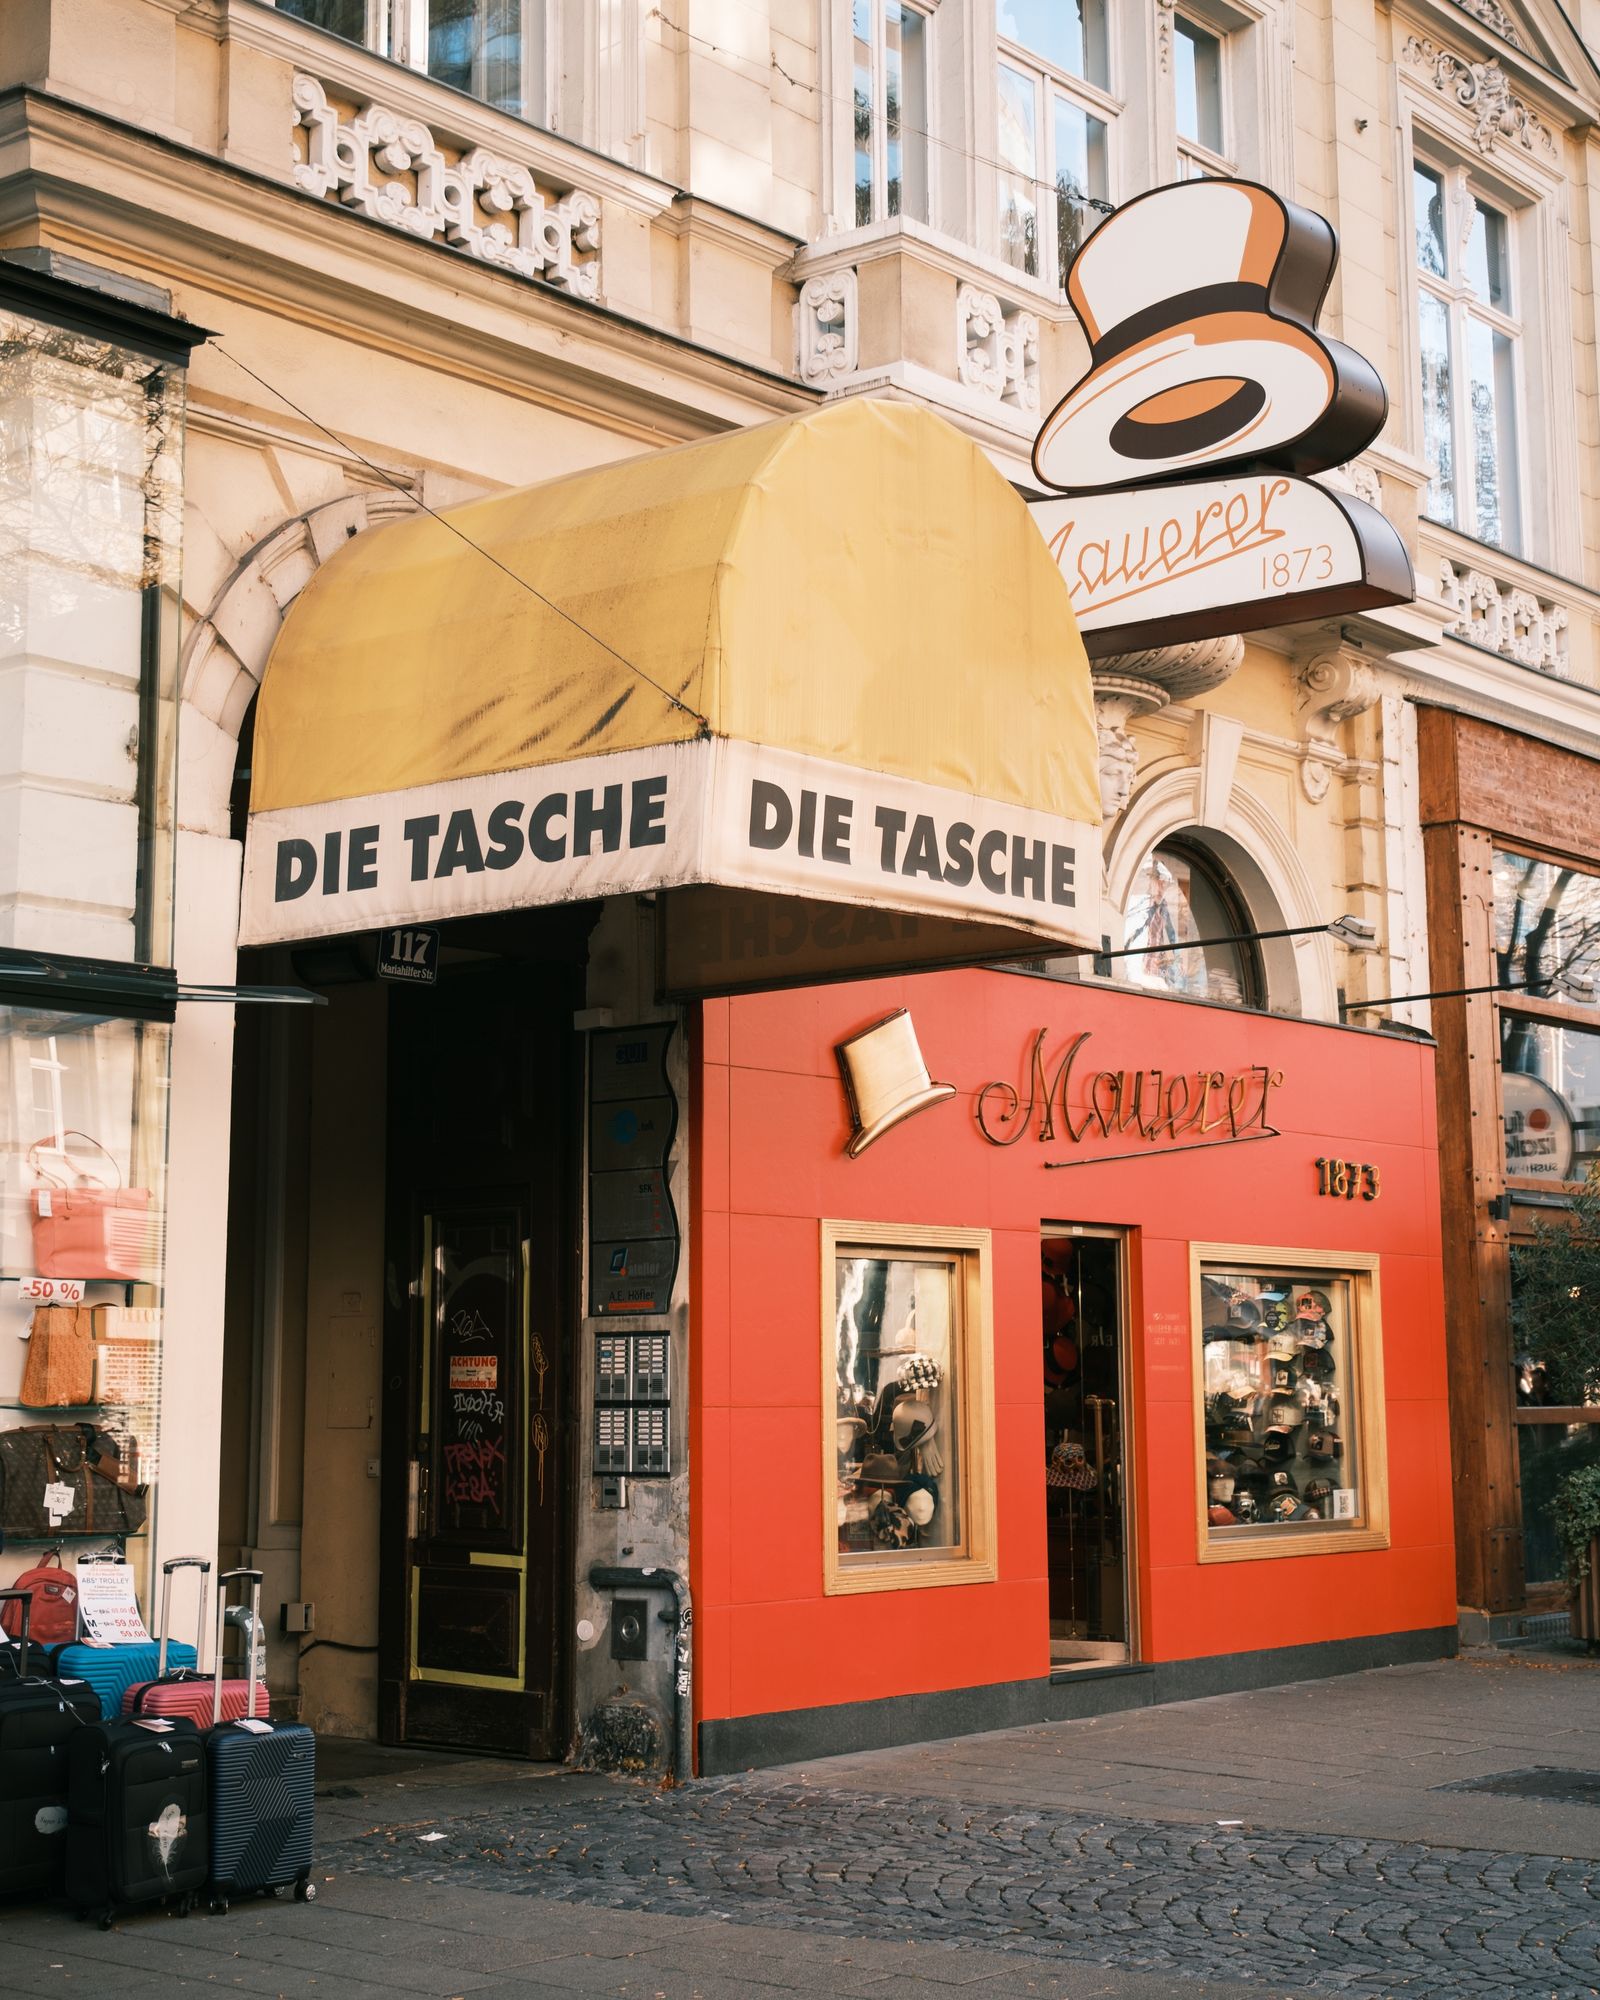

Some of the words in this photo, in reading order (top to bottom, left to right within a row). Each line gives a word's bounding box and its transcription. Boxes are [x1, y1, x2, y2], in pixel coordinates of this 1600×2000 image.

[1260, 544, 1335, 591] 1873
[275, 825, 379, 903] DIE
[404, 775, 668, 881] TASCHE
[749, 778, 855, 865] DIE
[875, 805, 1076, 907] TASCHE
[390, 929, 432, 965] 117
[381, 962, 421, 978] Mariahilfer
[421, 968, 434, 980] Str.
[975, 1027, 1284, 1148] Mauerer
[1315, 1156, 1381, 1201] 1873
[23, 1280, 54, 1298] -50
[60, 1282, 80, 1300] %
[451, 1356, 497, 1368] ACHTUNG
[450, 1377, 487, 1389] Automatisches
[84, 1607, 91, 1615] L
[115, 1619, 141, 1628] 59,00
[120, 1630, 147, 1638] 59,00
